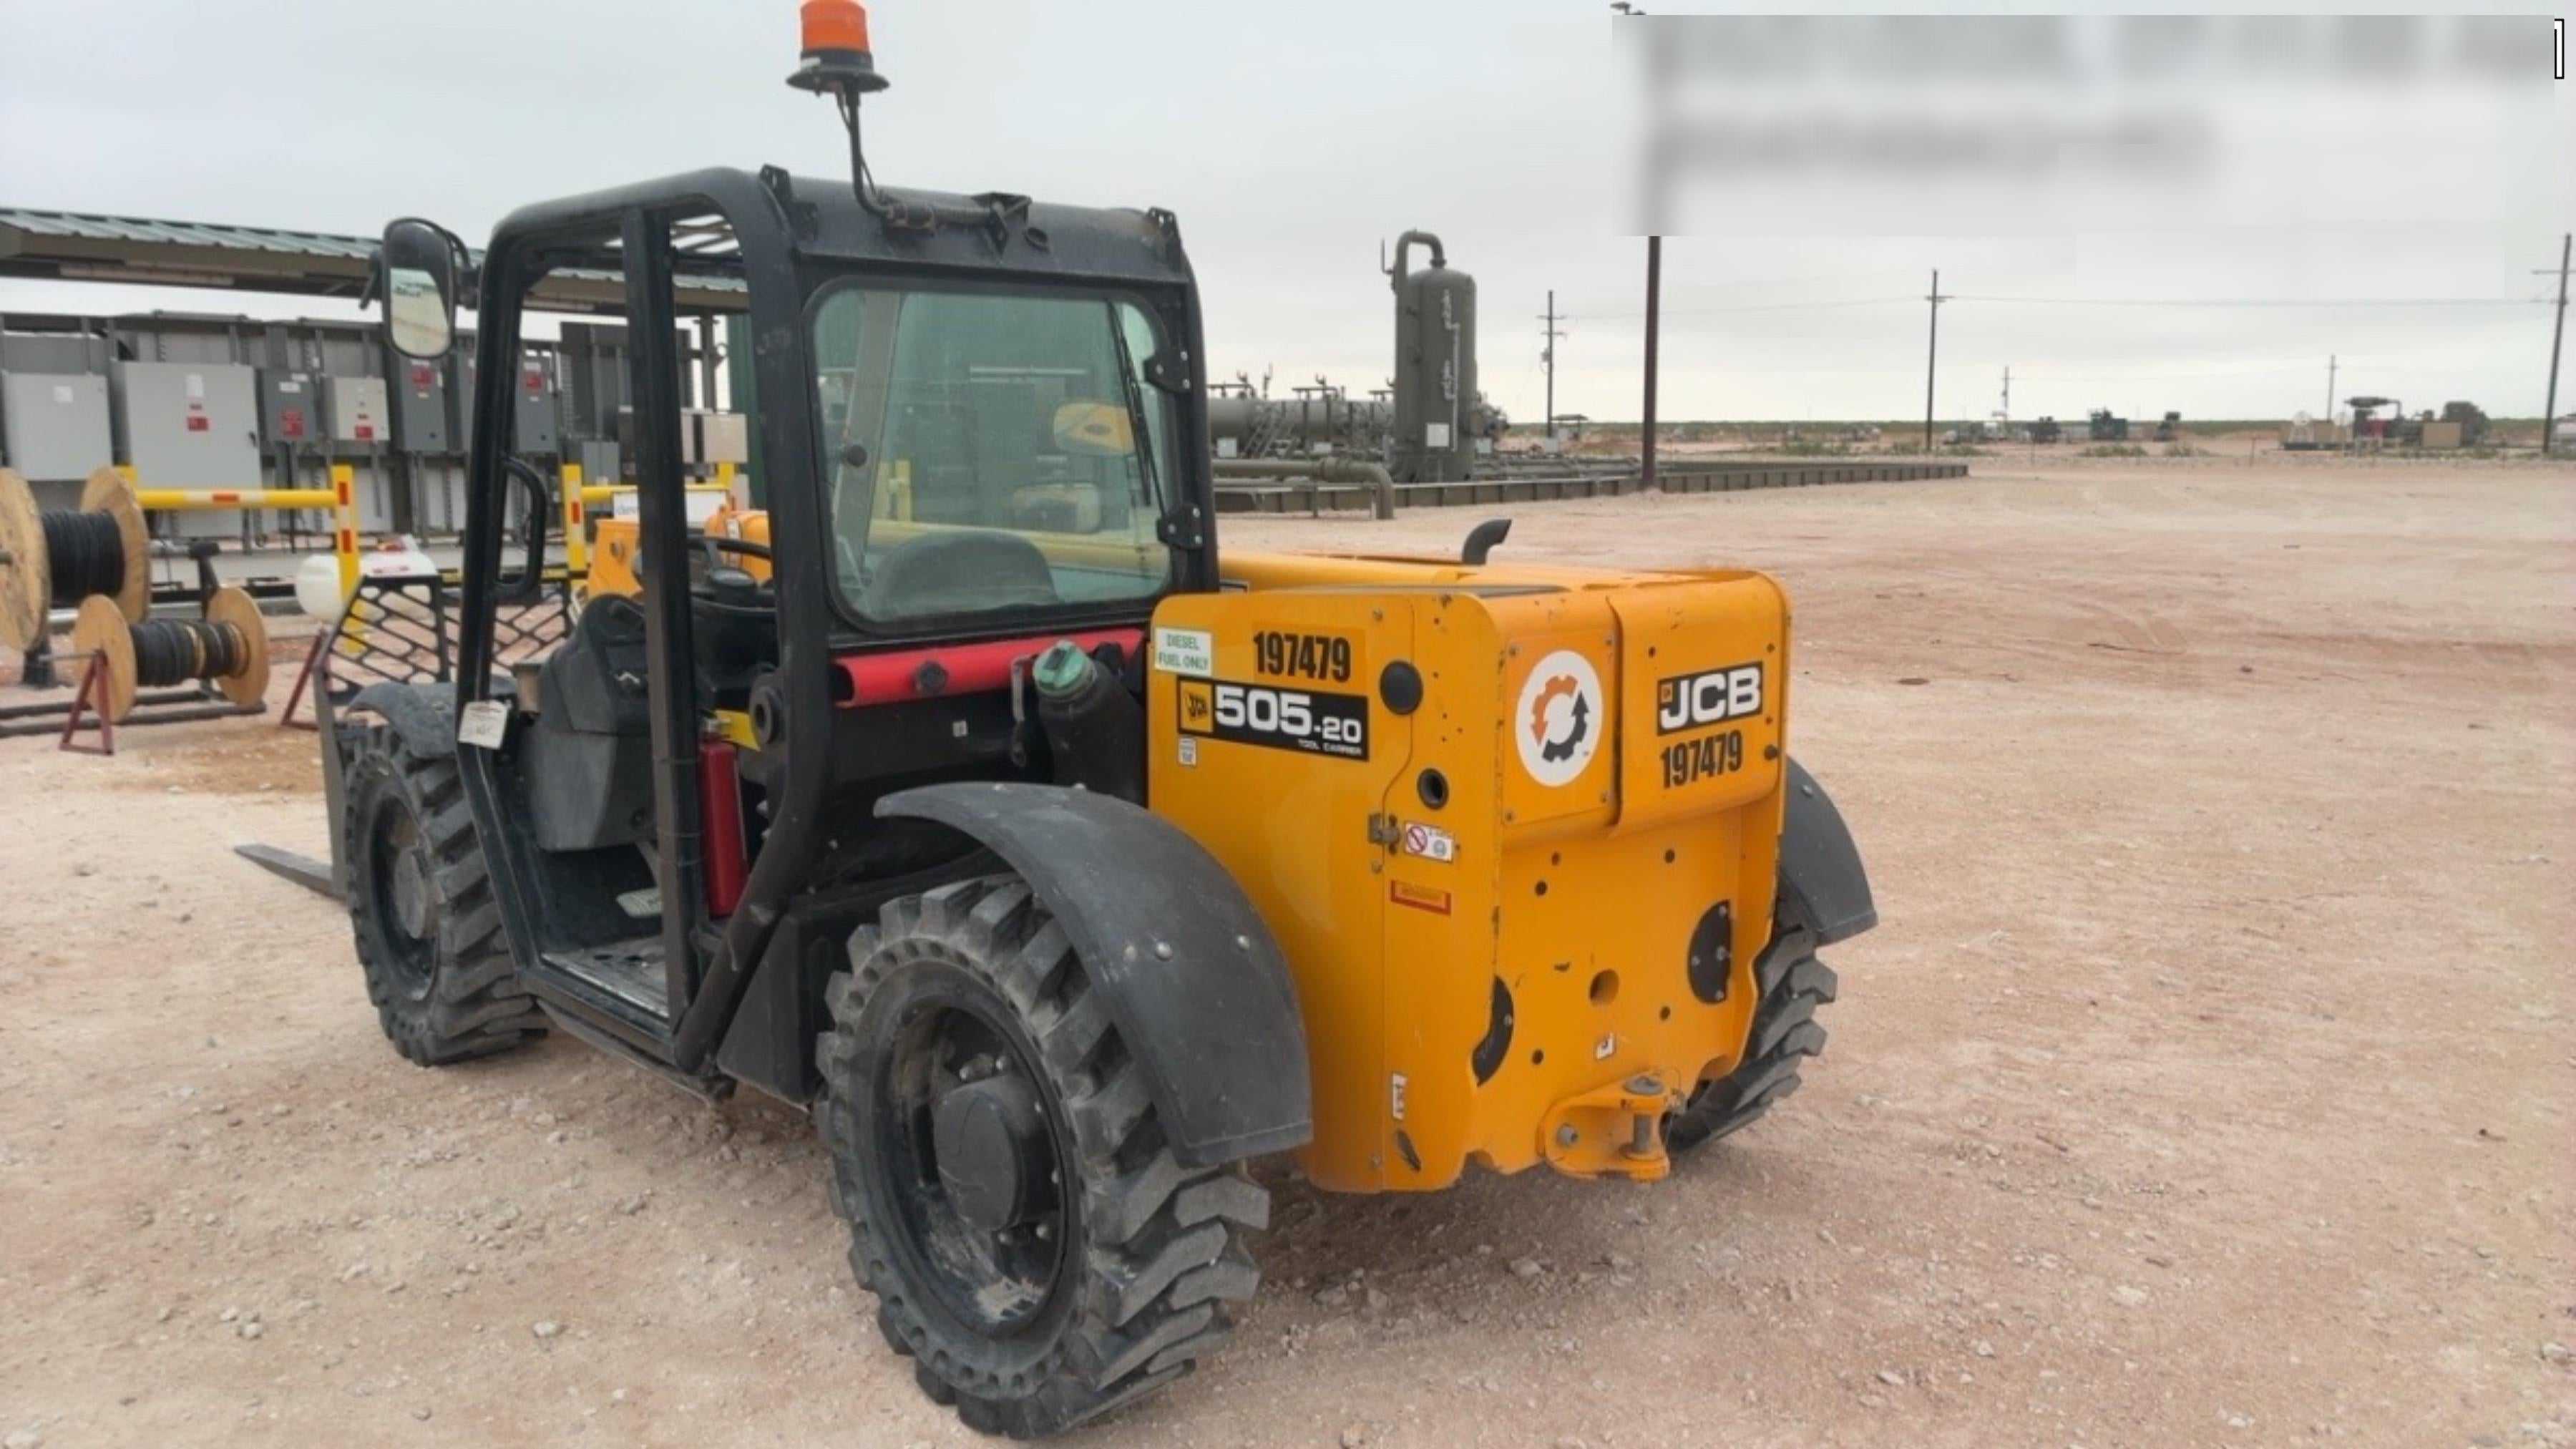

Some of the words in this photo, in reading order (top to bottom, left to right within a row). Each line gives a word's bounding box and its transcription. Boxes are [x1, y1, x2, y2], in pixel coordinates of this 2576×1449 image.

[1158, 651, 1181, 666] FUEL
[1183, 654, 1209, 670] ONLY
[1166, 633, 1200, 651] DIESEL
[1254, 630, 1351, 683] 197479
[1660, 666, 1761, 730] JCB
[1660, 729, 1742, 789] 197479
